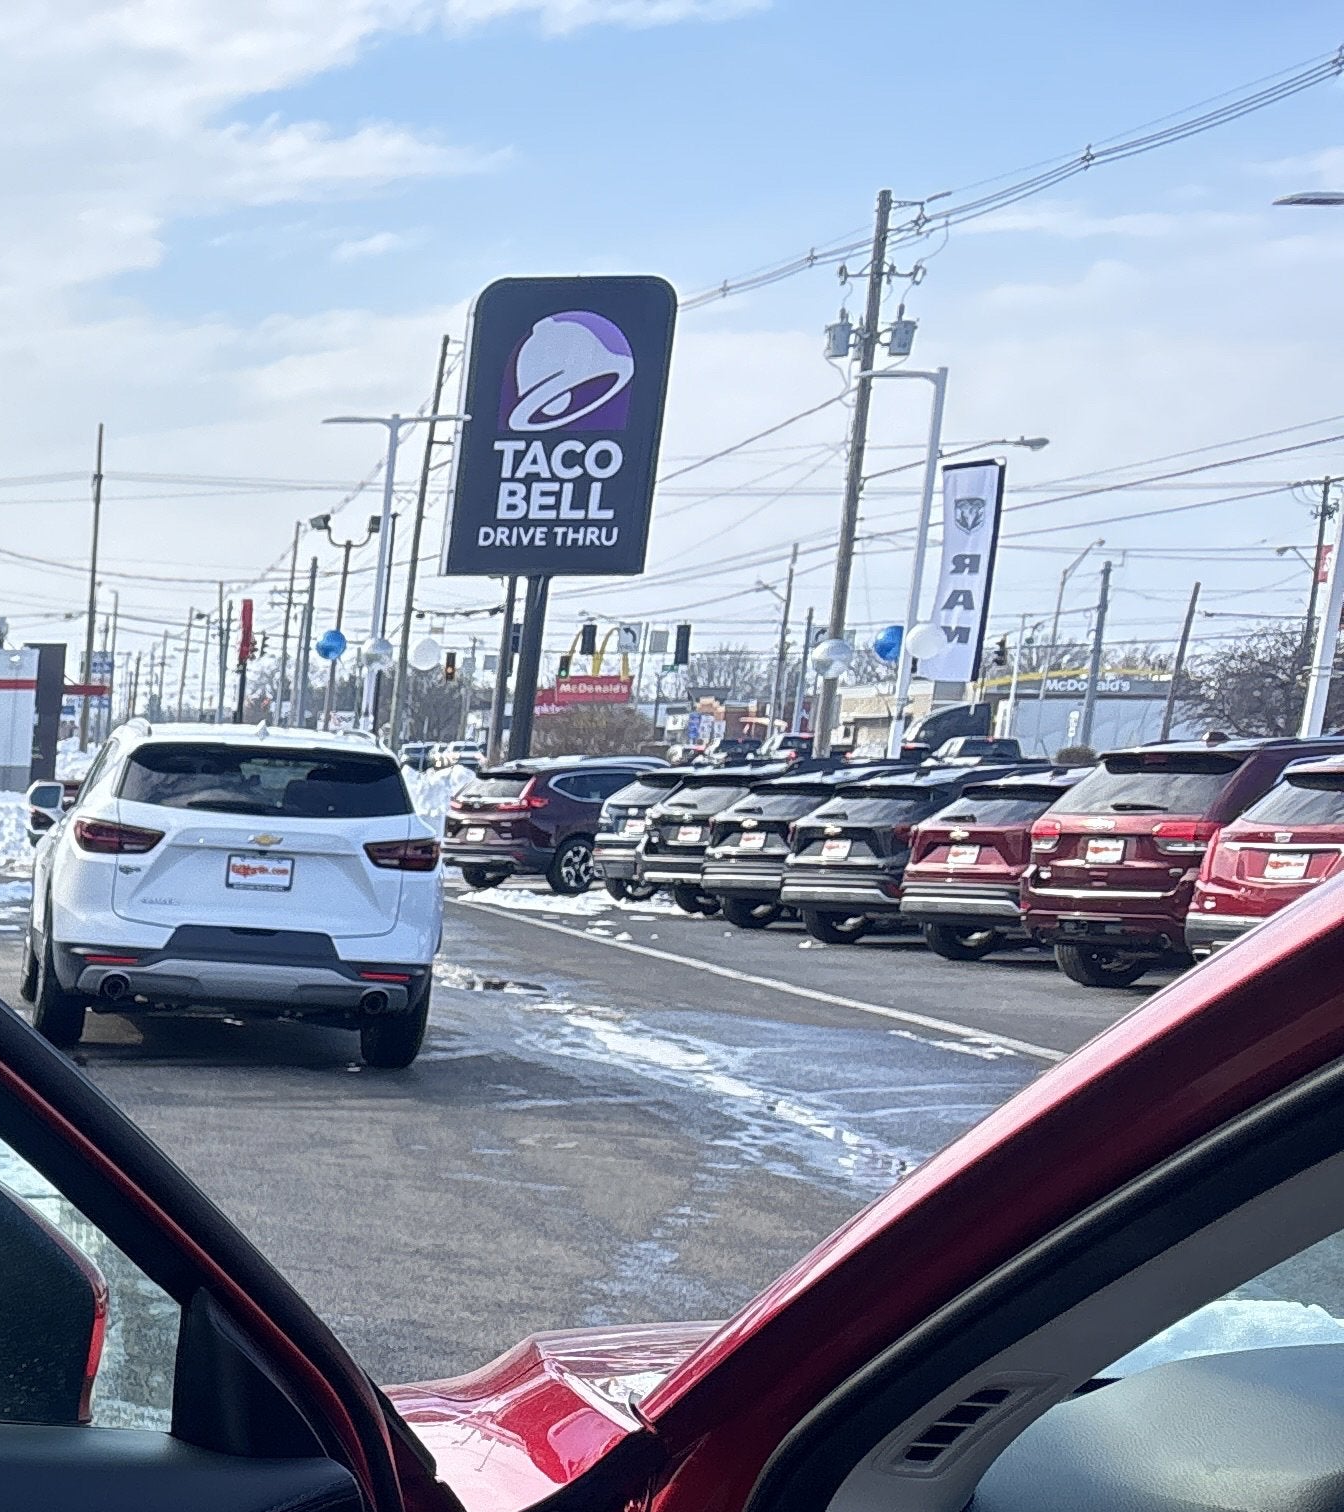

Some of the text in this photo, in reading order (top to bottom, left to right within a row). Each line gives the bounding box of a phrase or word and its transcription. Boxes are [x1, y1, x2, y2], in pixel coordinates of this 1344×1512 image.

[494, 439, 624, 479] TACO
[496, 481, 615, 520] BELL
[478, 526, 618, 547] DRIVE THRU
[561, 682, 629, 694] McDonald's
[1045, 679, 1131, 692] McDoald's
